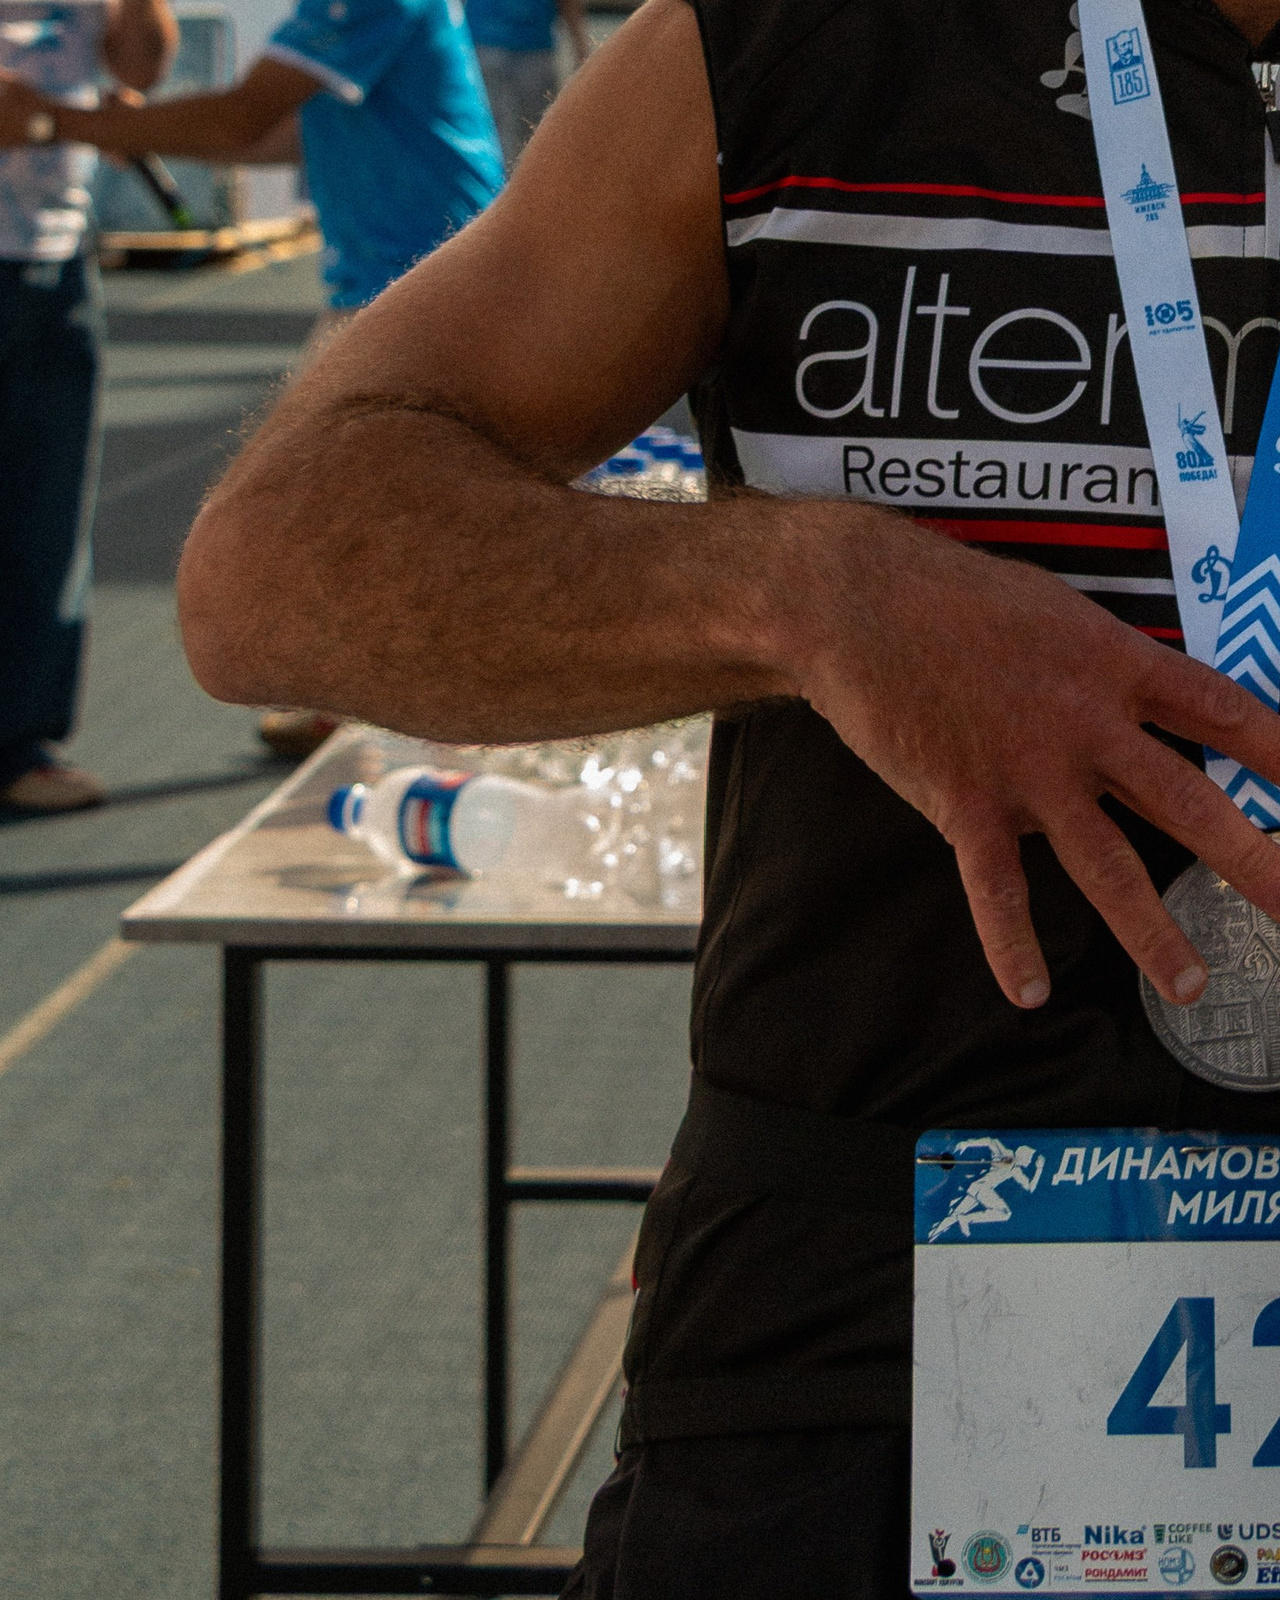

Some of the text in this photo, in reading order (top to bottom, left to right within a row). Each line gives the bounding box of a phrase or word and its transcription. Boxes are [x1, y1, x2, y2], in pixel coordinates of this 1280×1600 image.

[1116, 68, 1145, 99] 185
[841, 443, 1160, 506] Restauran
[1031, 1527, 1062, 1543] ВТБ
[1084, 1525, 1145, 1545] Nika
[1168, 1523, 1213, 1534] COFFEE
[1168, 1533, 1194, 1545] LIKE
[1085, 1566, 1149, 1580] РОНДАМИТ
